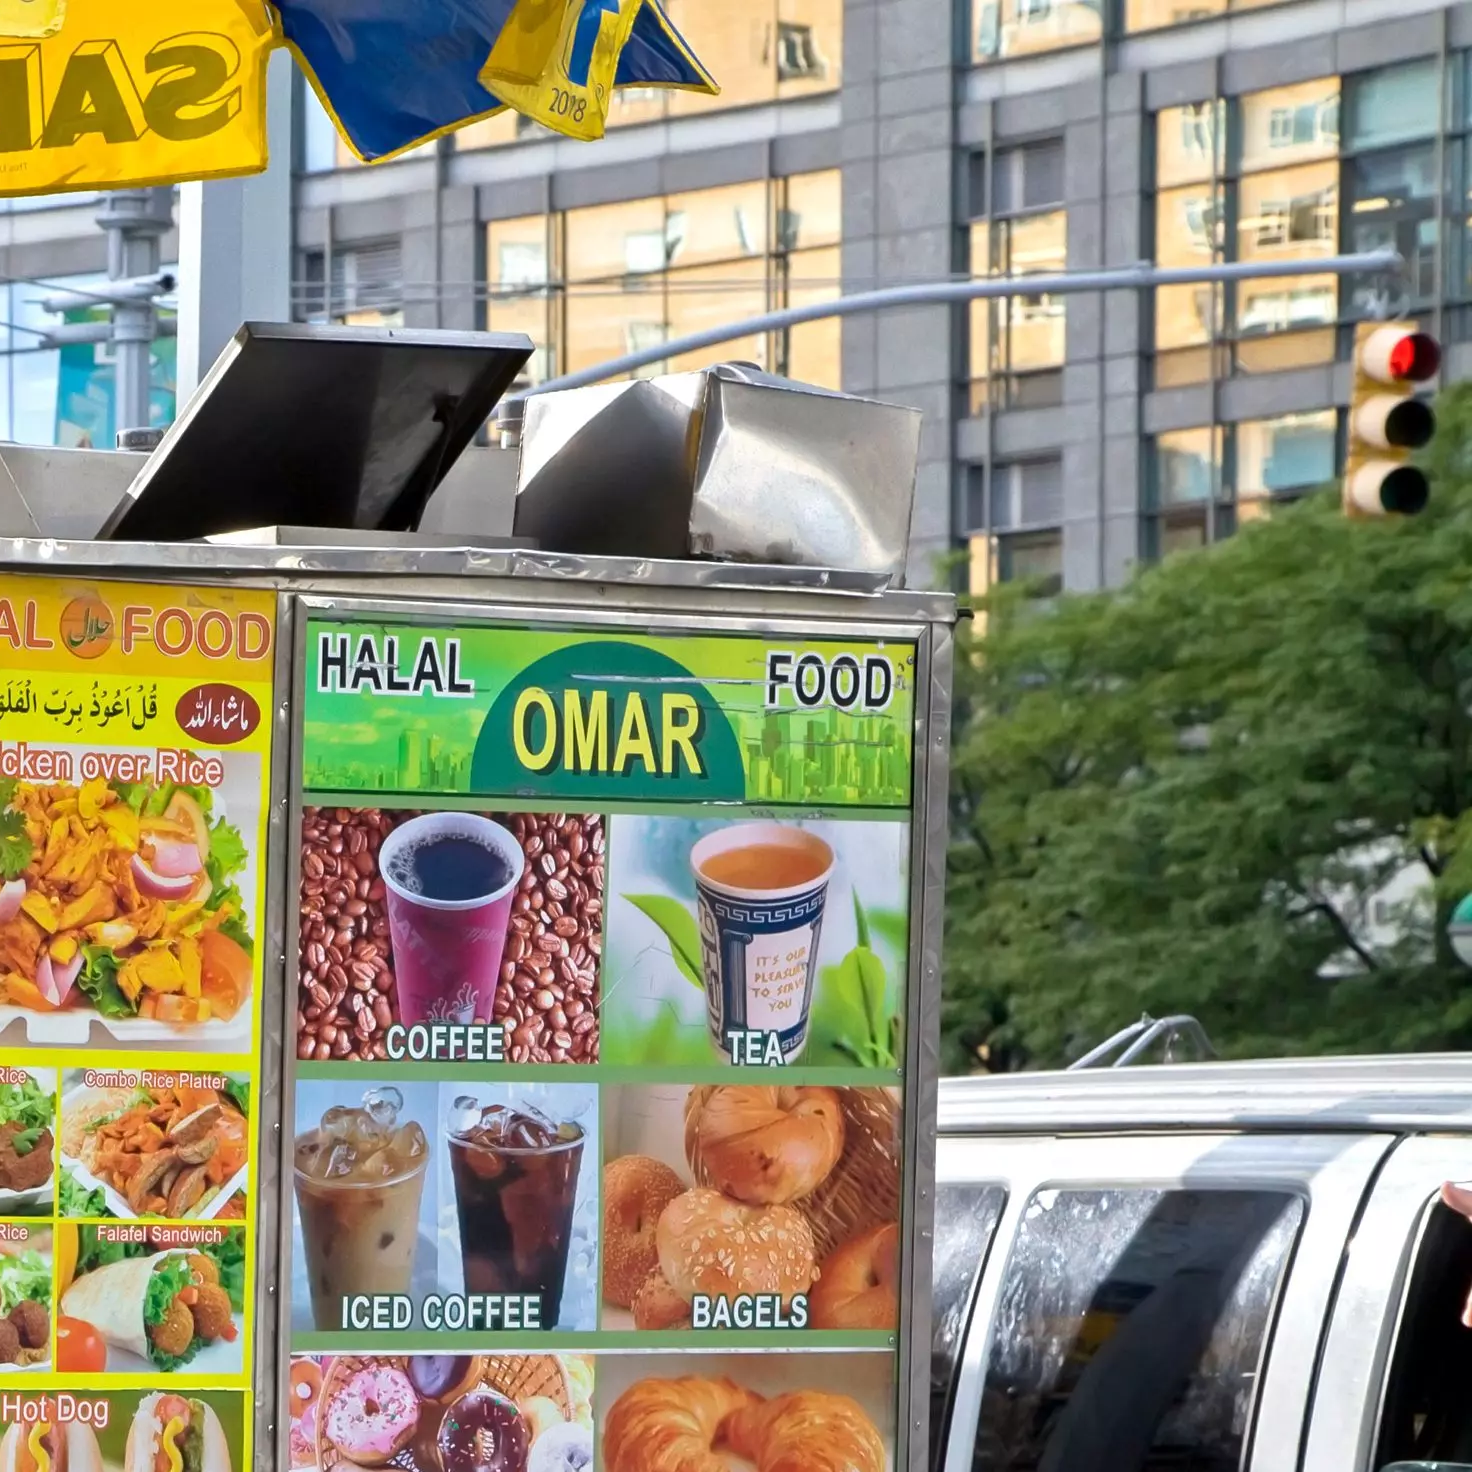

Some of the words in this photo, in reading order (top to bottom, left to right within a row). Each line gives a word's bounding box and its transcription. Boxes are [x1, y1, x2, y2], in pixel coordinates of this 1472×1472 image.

[550, 87, 588, 123] 2018
[122, 606, 272, 661] FOOD
[319, 633, 474, 695] HALAL
[767, 652, 894, 710] FOOD
[512, 686, 706, 779] OMAR
[80, 757, 148, 782] over
[156, 751, 223, 786] Rice
[386, 1024, 504, 1061] COFFEE
[727, 1030, 785, 1066] TEA
[84, 1070, 137, 1089] Combo
[141, 1071, 174, 1090] Rice
[178, 1072, 228, 1091] Platter
[97, 1224, 147, 1242] Falafel
[151, 1225, 222, 1243] Sandwich
[341, 1294, 412, 1330] ICED
[422, 1294, 541, 1330] COFFEE
[692, 1294, 808, 1330] BAGELS
[2, 1394, 47, 1424] Hot
[57, 1396, 110, 1428] Dog
